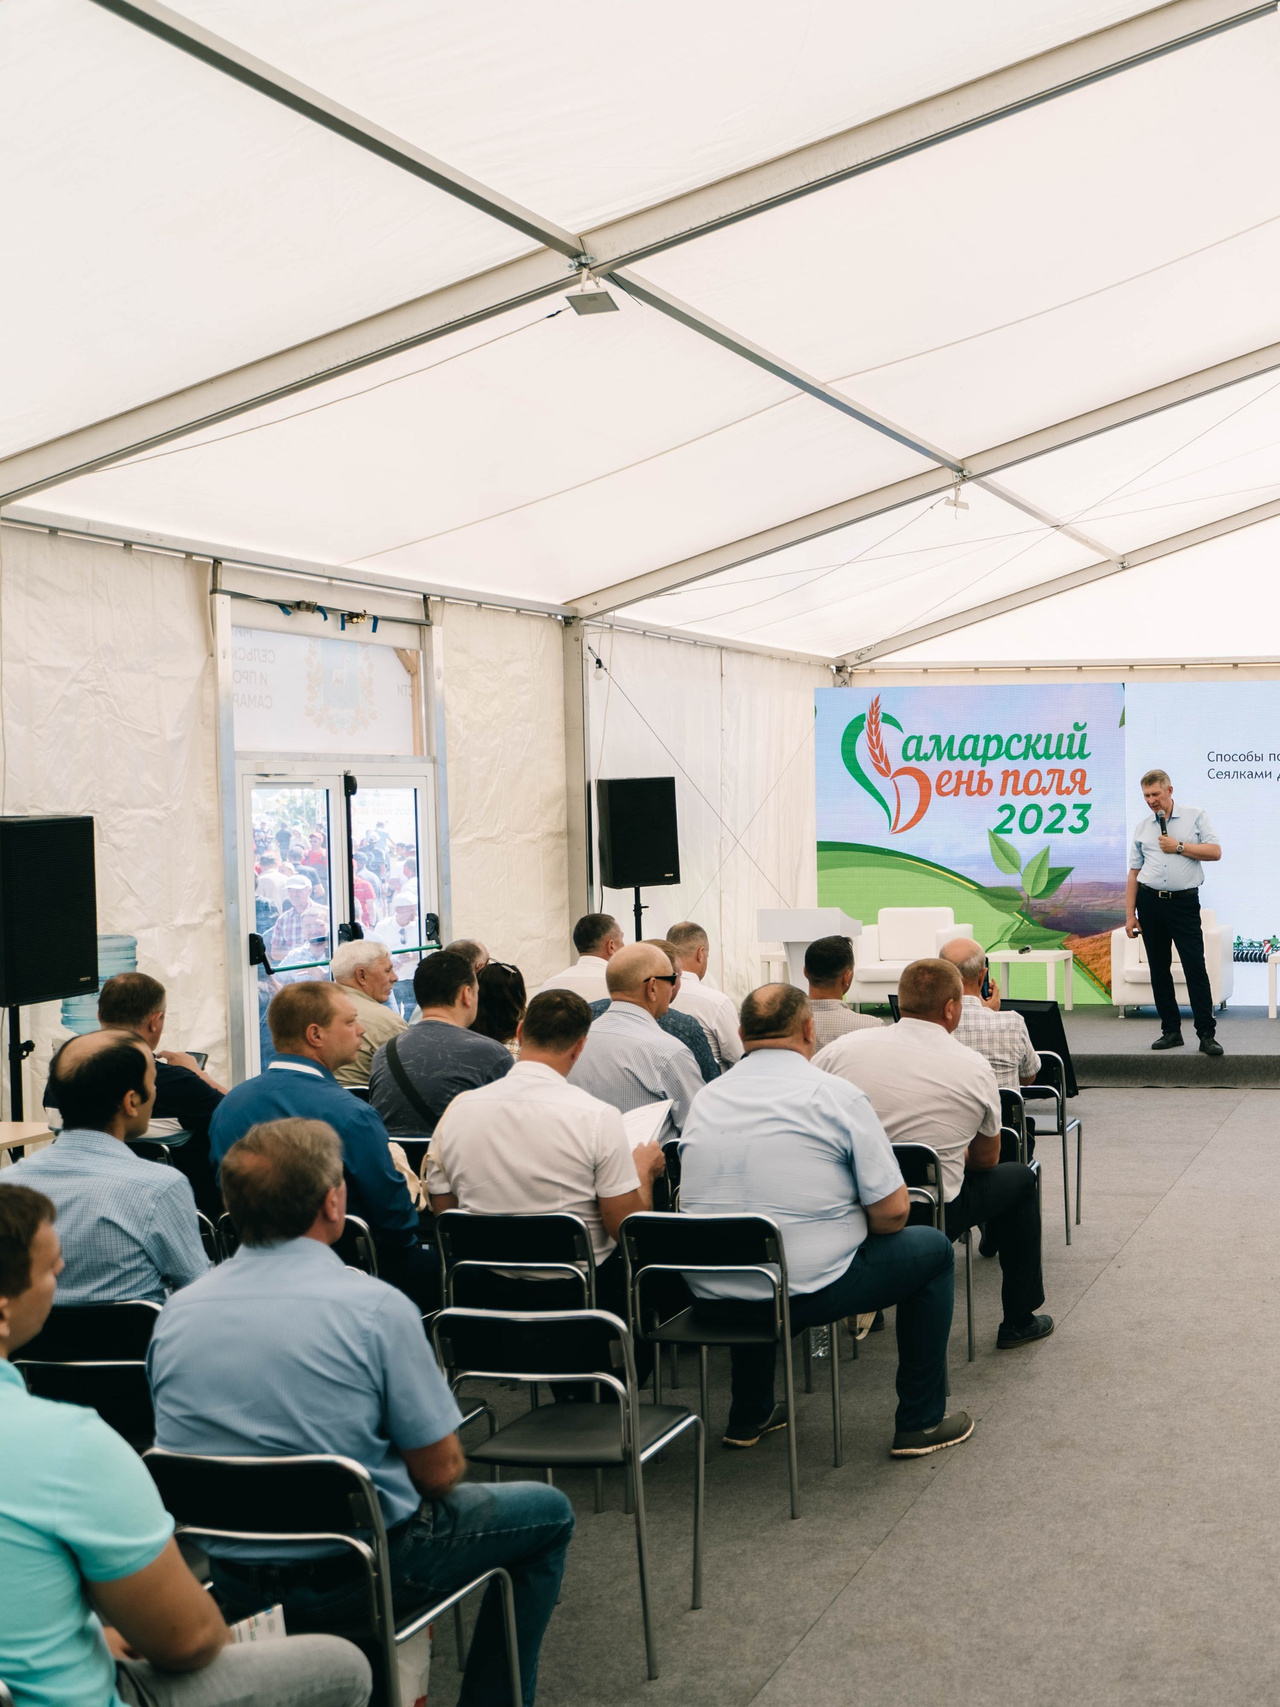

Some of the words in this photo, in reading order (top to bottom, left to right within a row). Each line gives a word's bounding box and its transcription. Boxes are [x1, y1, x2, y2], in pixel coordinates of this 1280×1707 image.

[1207, 749, 1264, 763] Способы
[999, 767, 1092, 797] поля
[1207, 768, 1272, 780] Сеялками
[992, 803, 1092, 835] 2023
